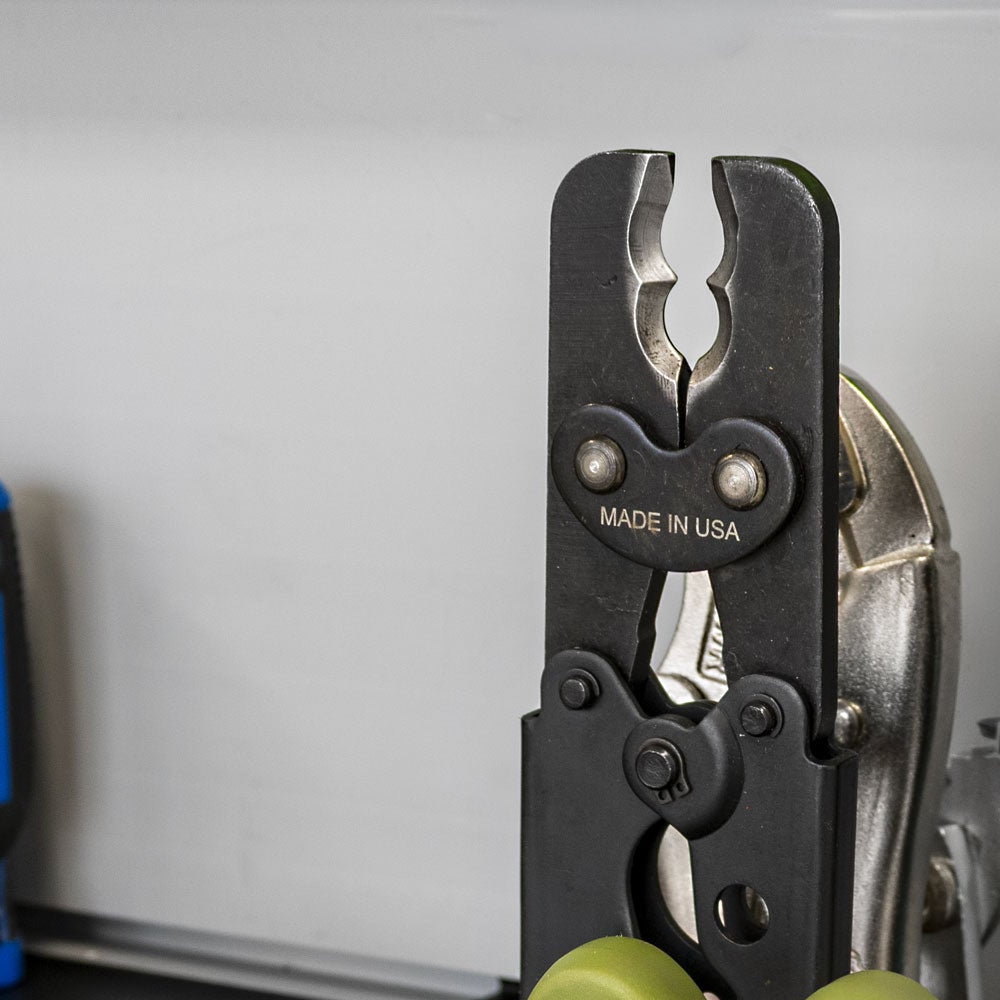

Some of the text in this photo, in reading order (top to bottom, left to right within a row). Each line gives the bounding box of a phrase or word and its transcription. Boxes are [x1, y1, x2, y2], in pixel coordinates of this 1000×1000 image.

[600, 506, 741, 542] MADE IN USA
